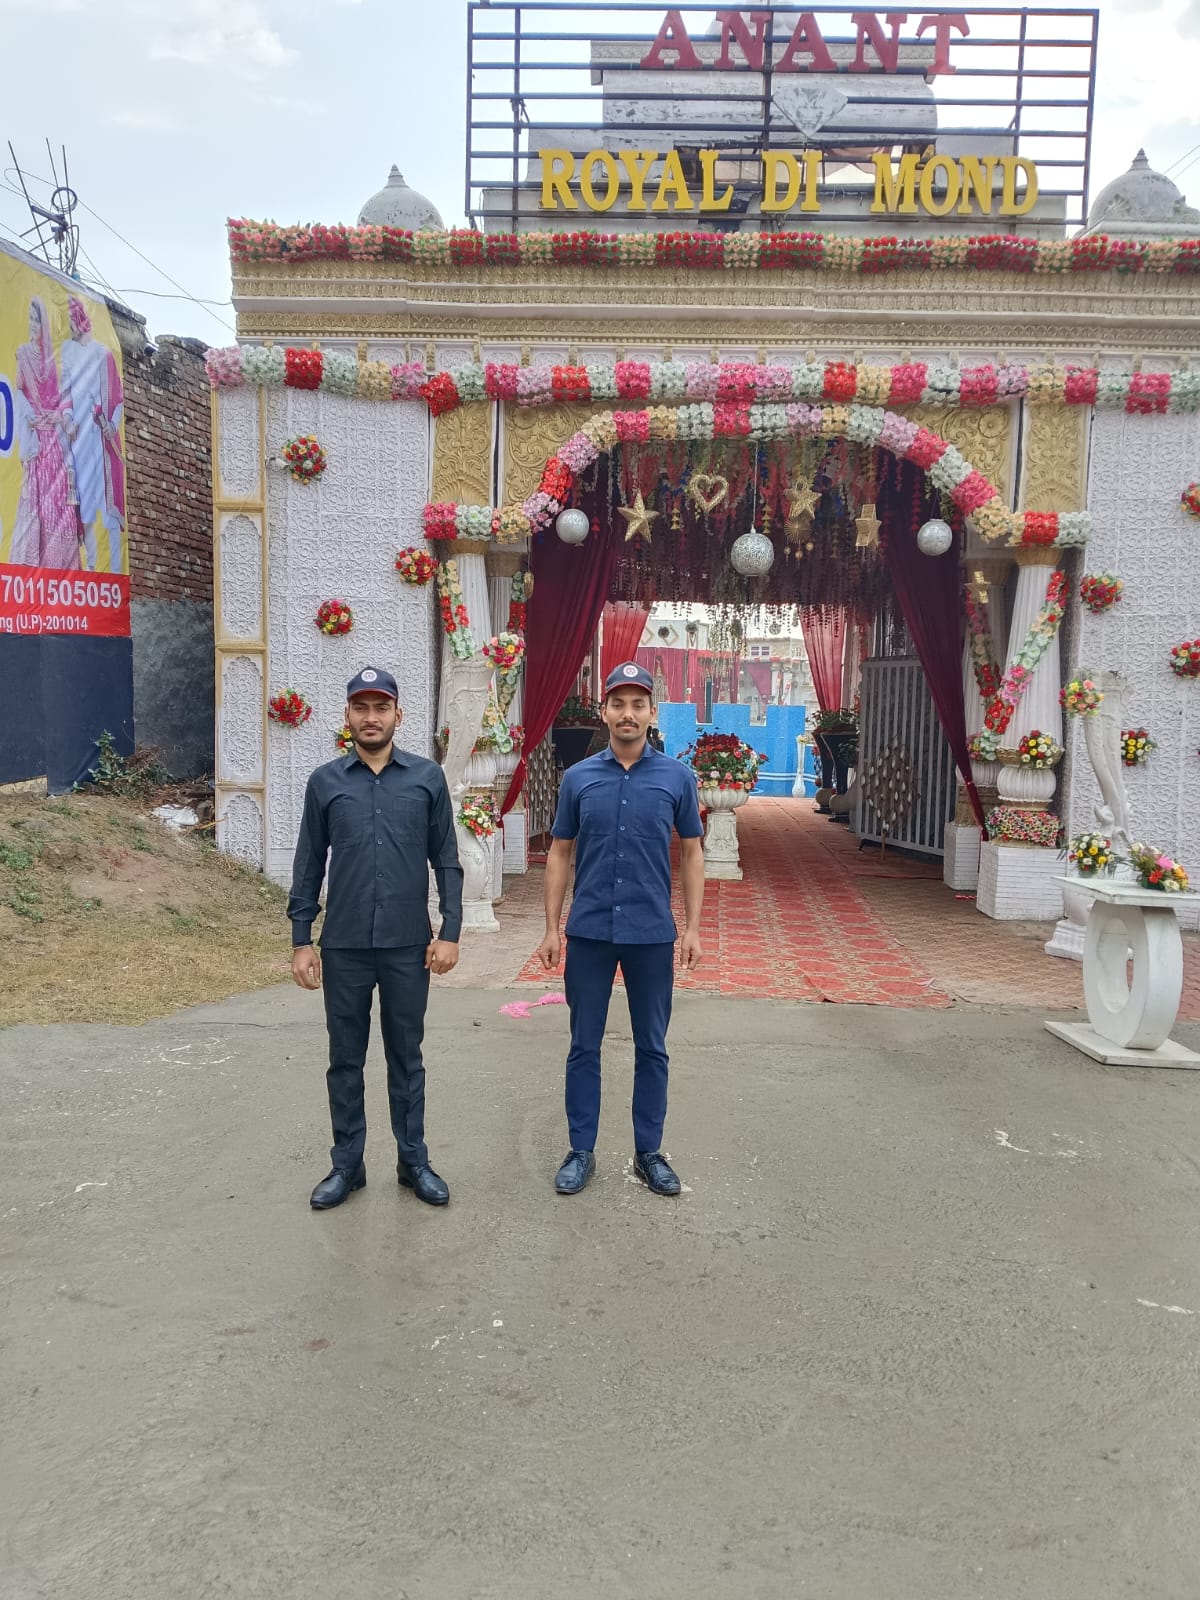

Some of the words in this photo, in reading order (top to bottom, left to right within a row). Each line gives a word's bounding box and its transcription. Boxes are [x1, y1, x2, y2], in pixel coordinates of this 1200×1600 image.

[640, 10, 970, 74] ANANT
[538, 148, 734, 212] ROYAL
[760, 149, 823, 212] DI
[870, 153, 1039, 216] MOND
[1, 575, 121, 608] 7011505059
